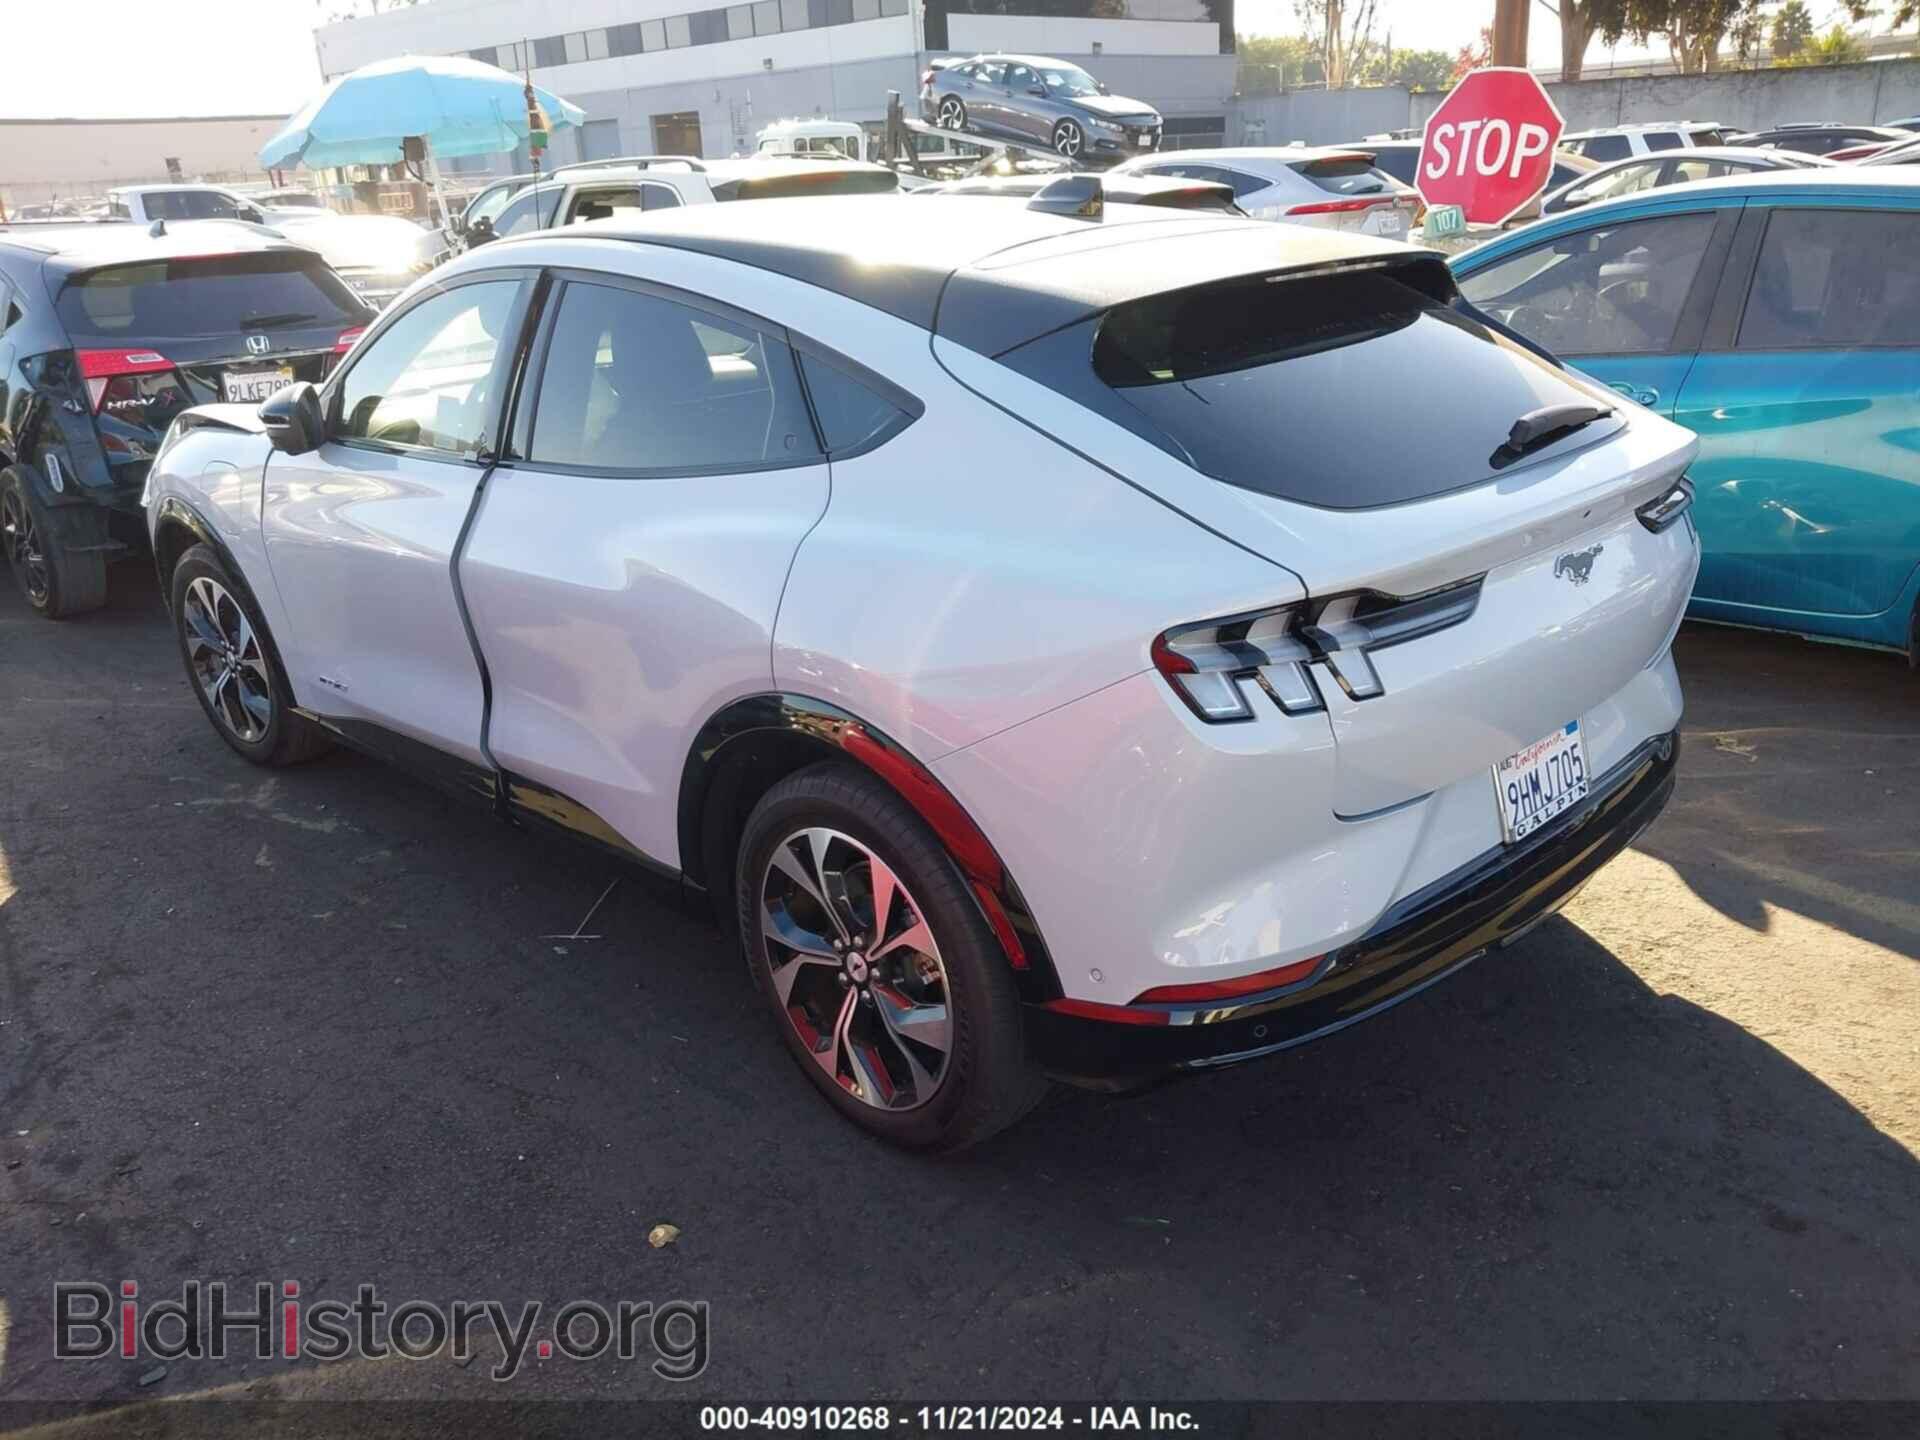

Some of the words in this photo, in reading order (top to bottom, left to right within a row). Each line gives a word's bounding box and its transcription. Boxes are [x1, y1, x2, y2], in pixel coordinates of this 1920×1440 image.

[1425, 118, 1550, 180] STOP
[1434, 210, 1458, 232] 107
[1507, 742, 1584, 826] 9HMJ705
[1516, 781, 1588, 837] GALPIN
